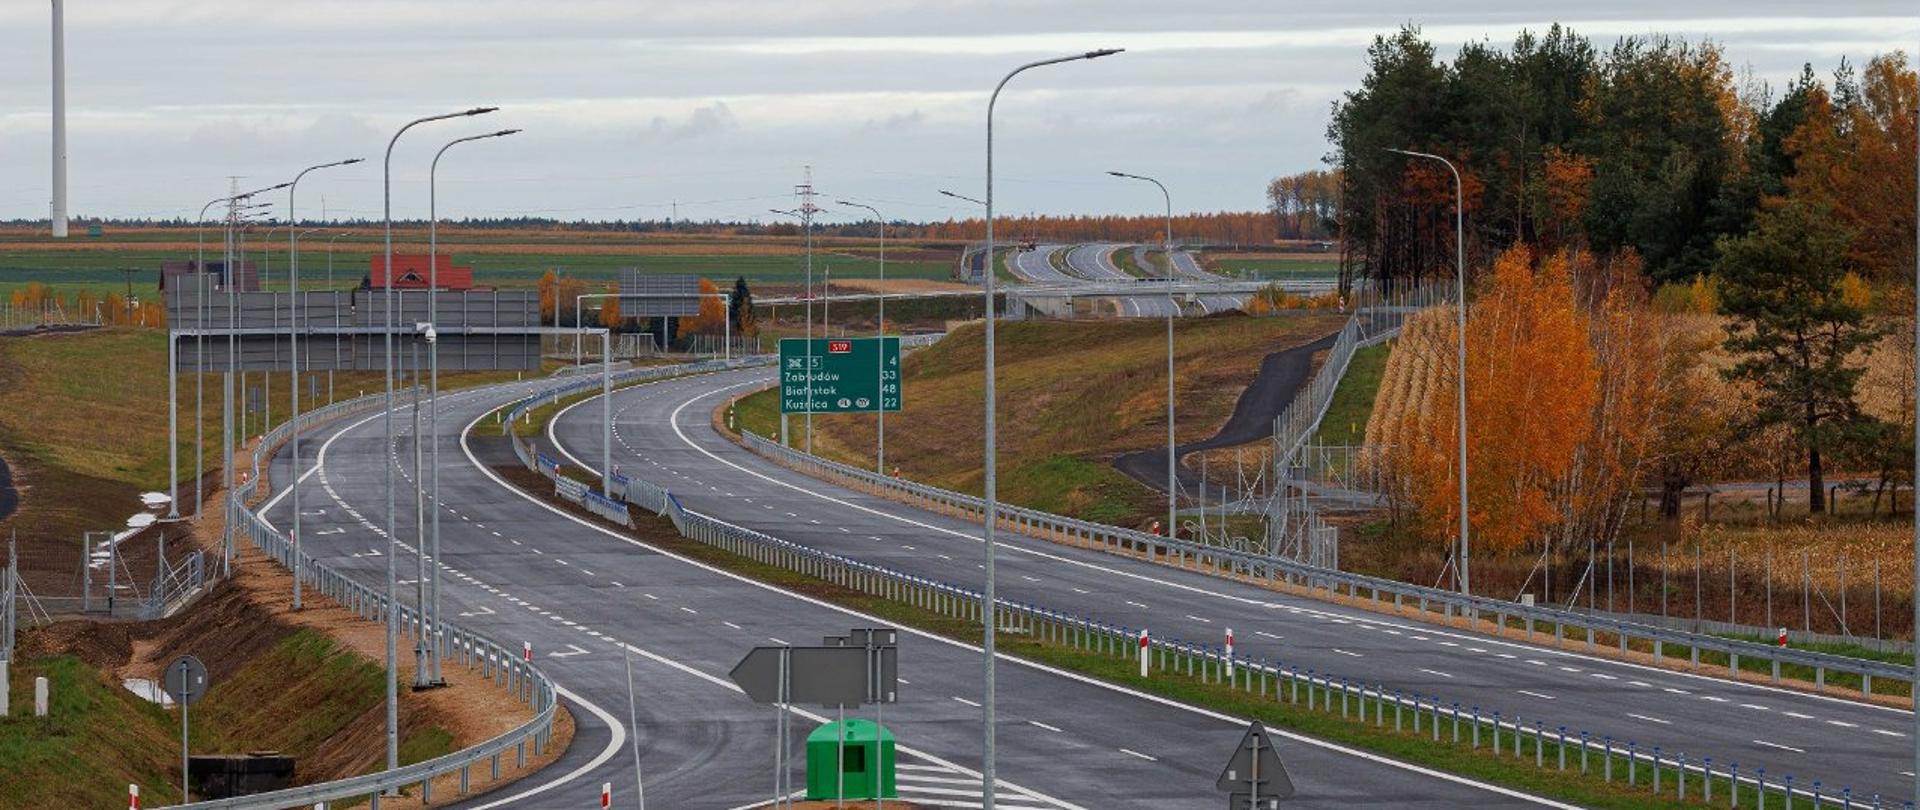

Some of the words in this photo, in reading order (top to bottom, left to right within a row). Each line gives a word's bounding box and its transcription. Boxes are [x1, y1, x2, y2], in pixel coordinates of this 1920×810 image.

[832, 343, 848, 351] S19
[889, 356, 897, 366] 4
[784, 371, 840, 382] Zabudów
[881, 370, 897, 380] 33
[785, 385, 837, 396] Białstok
[882, 384, 897, 394] 48
[785, 399, 828, 410] Kuźica
